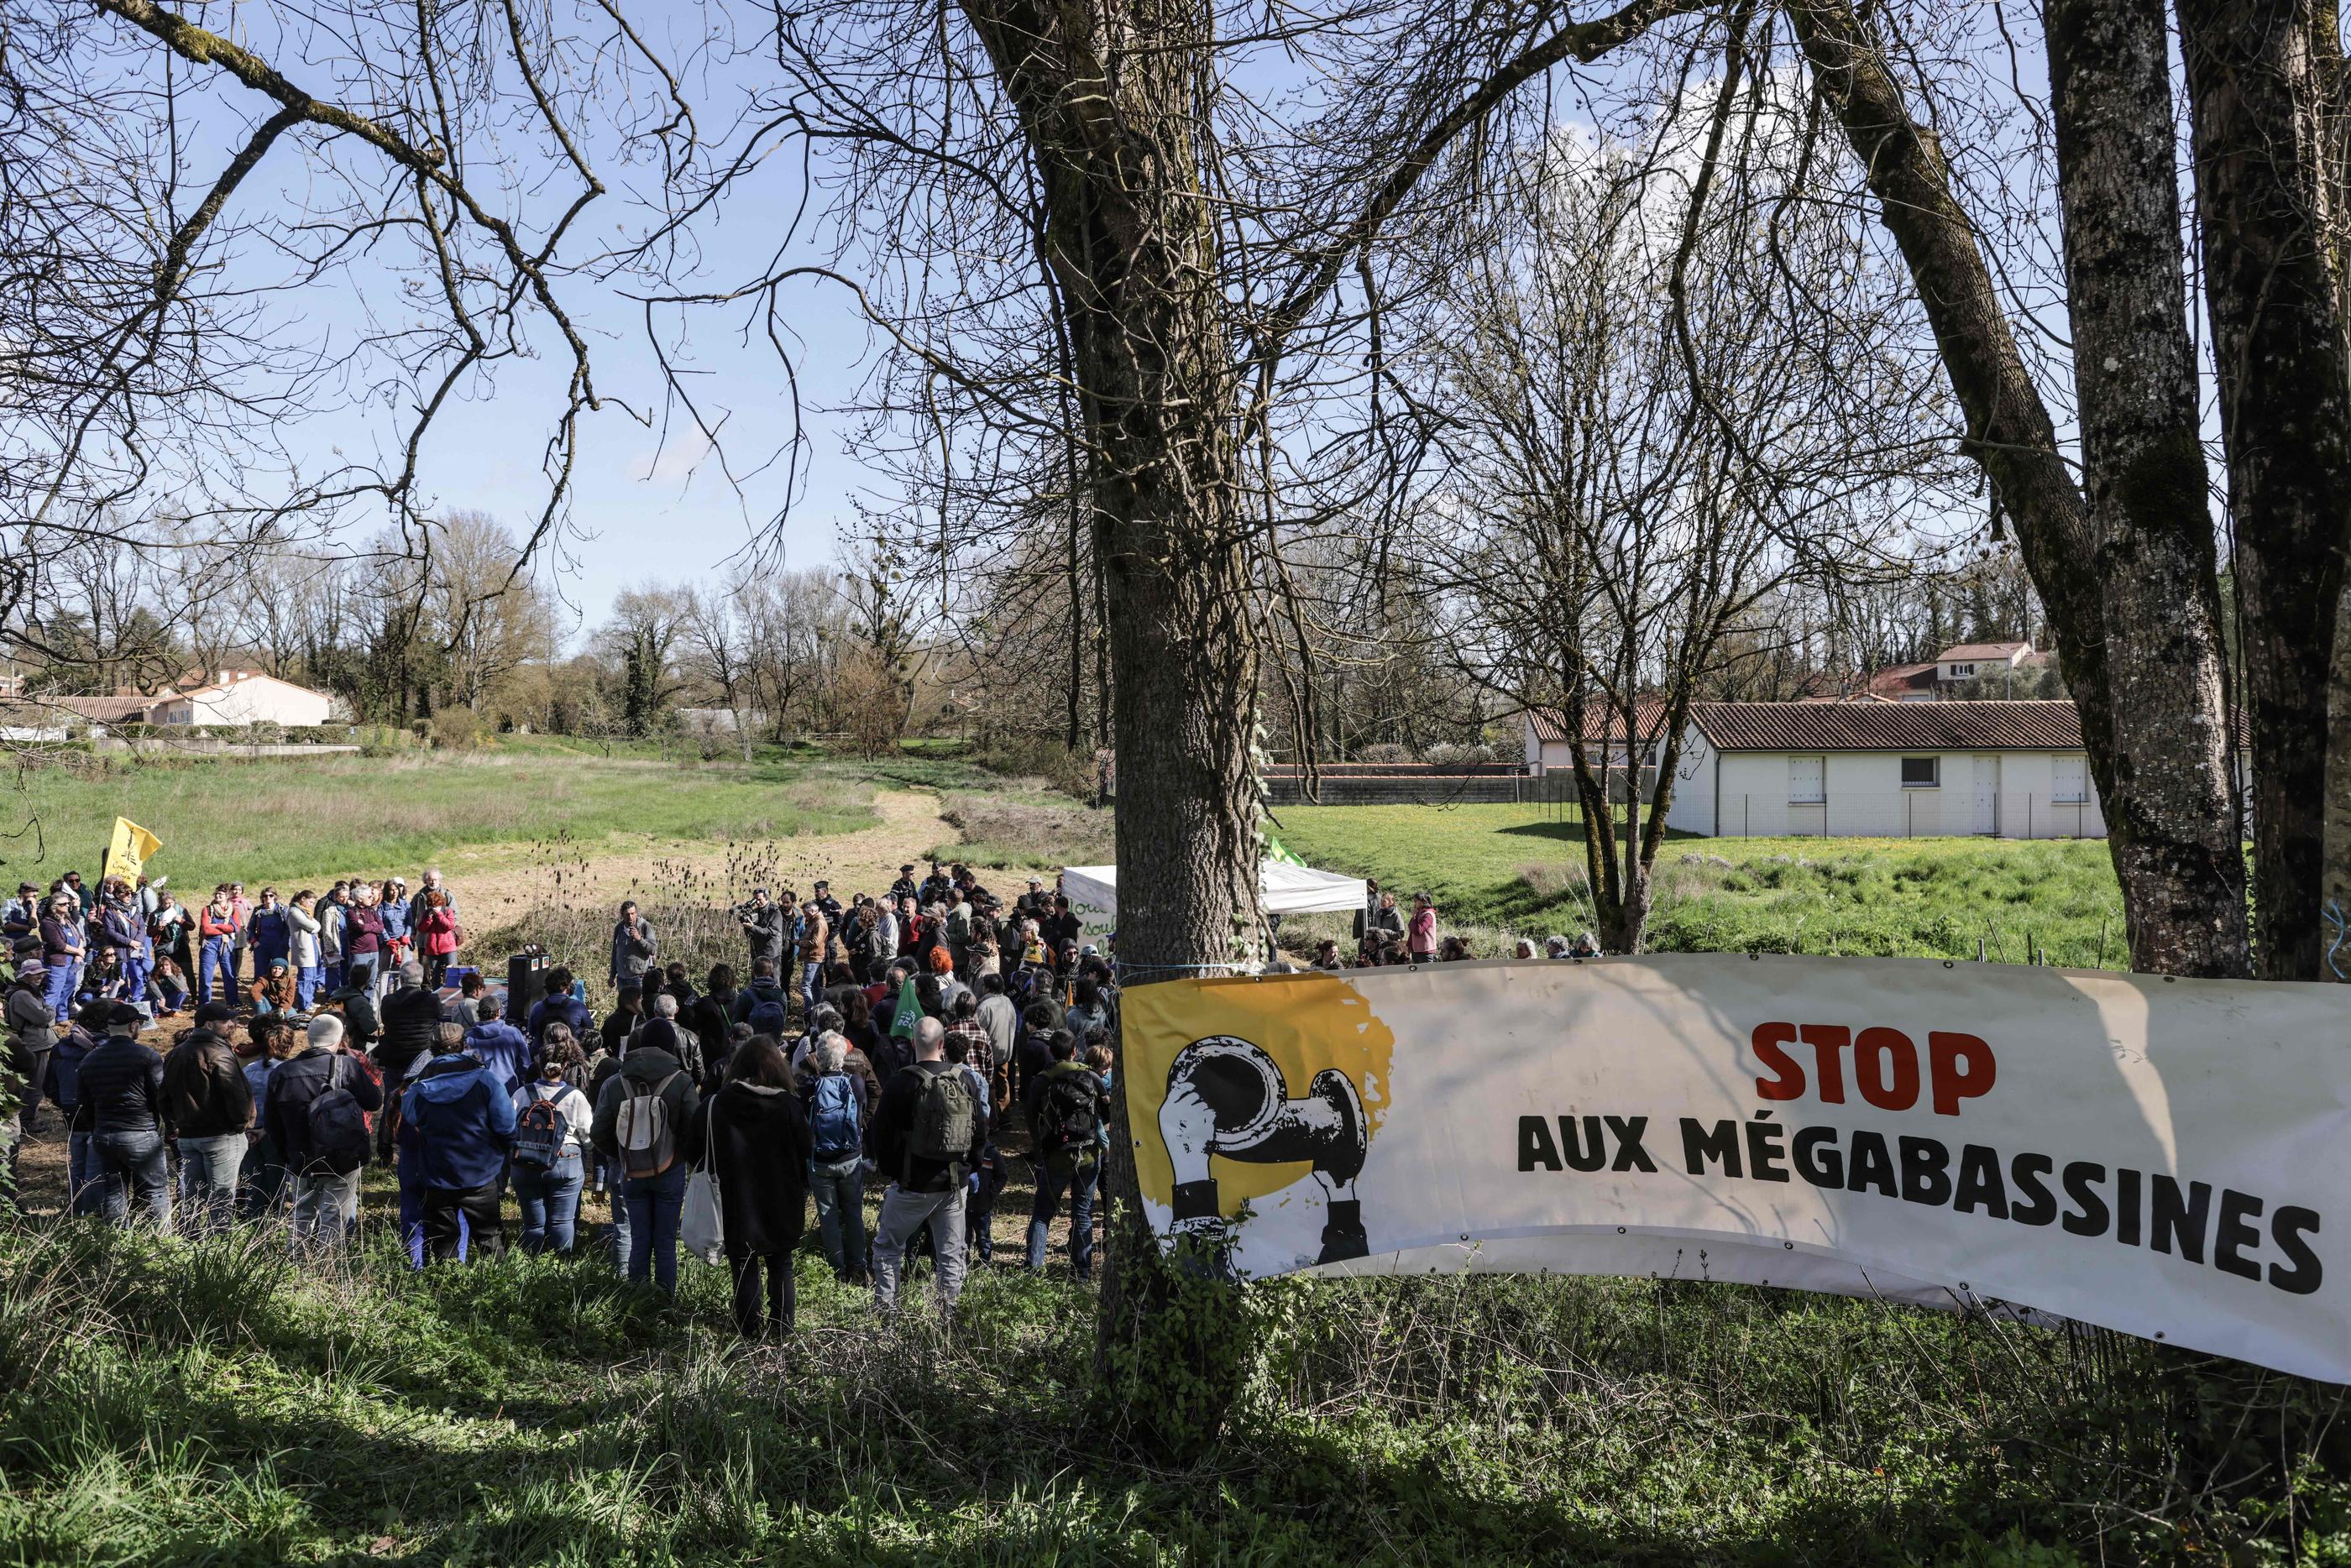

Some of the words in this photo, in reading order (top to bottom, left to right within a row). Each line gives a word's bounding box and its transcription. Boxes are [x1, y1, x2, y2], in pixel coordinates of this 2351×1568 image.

[1752, 1022, 1996, 1116] STOP
[1517, 1115, 1658, 1173] AUX
[1679, 1109, 2322, 1295] MÉGABASSINES
